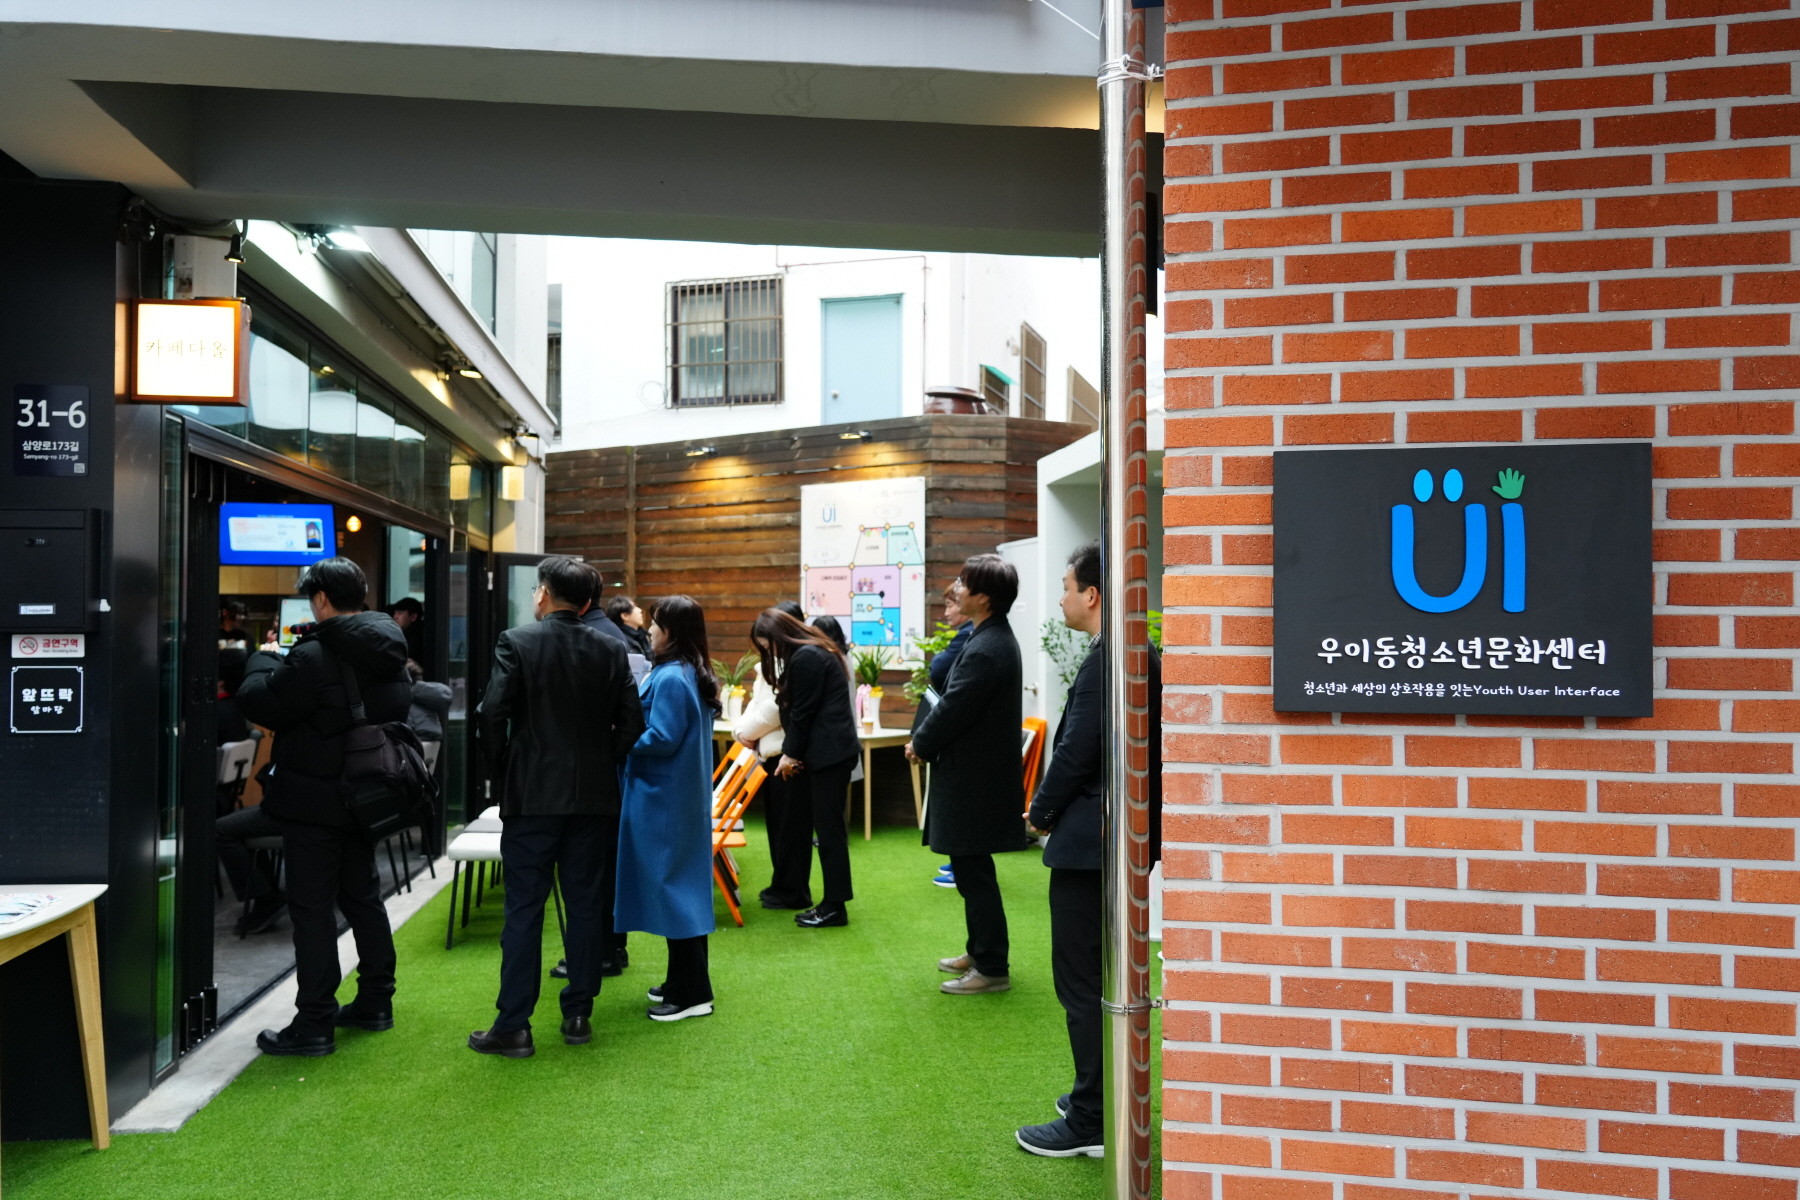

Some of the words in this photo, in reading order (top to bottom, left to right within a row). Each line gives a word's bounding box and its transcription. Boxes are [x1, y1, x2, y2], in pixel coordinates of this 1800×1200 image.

[17, 398, 87, 429] 31-6
[22, 440, 80, 452] 삼양로173길
[42, 638, 79, 648] 금연구역
[1317, 634, 1607, 671] 우이동청소년문화센터
[1303, 680, 1349, 696] 청소년과
[1351, 682, 1387, 697] 세상의
[1389, 682, 1446, 698] 상호작용을
[1517, 685, 1550, 697] User
[1554, 685, 1621, 697] Interface
